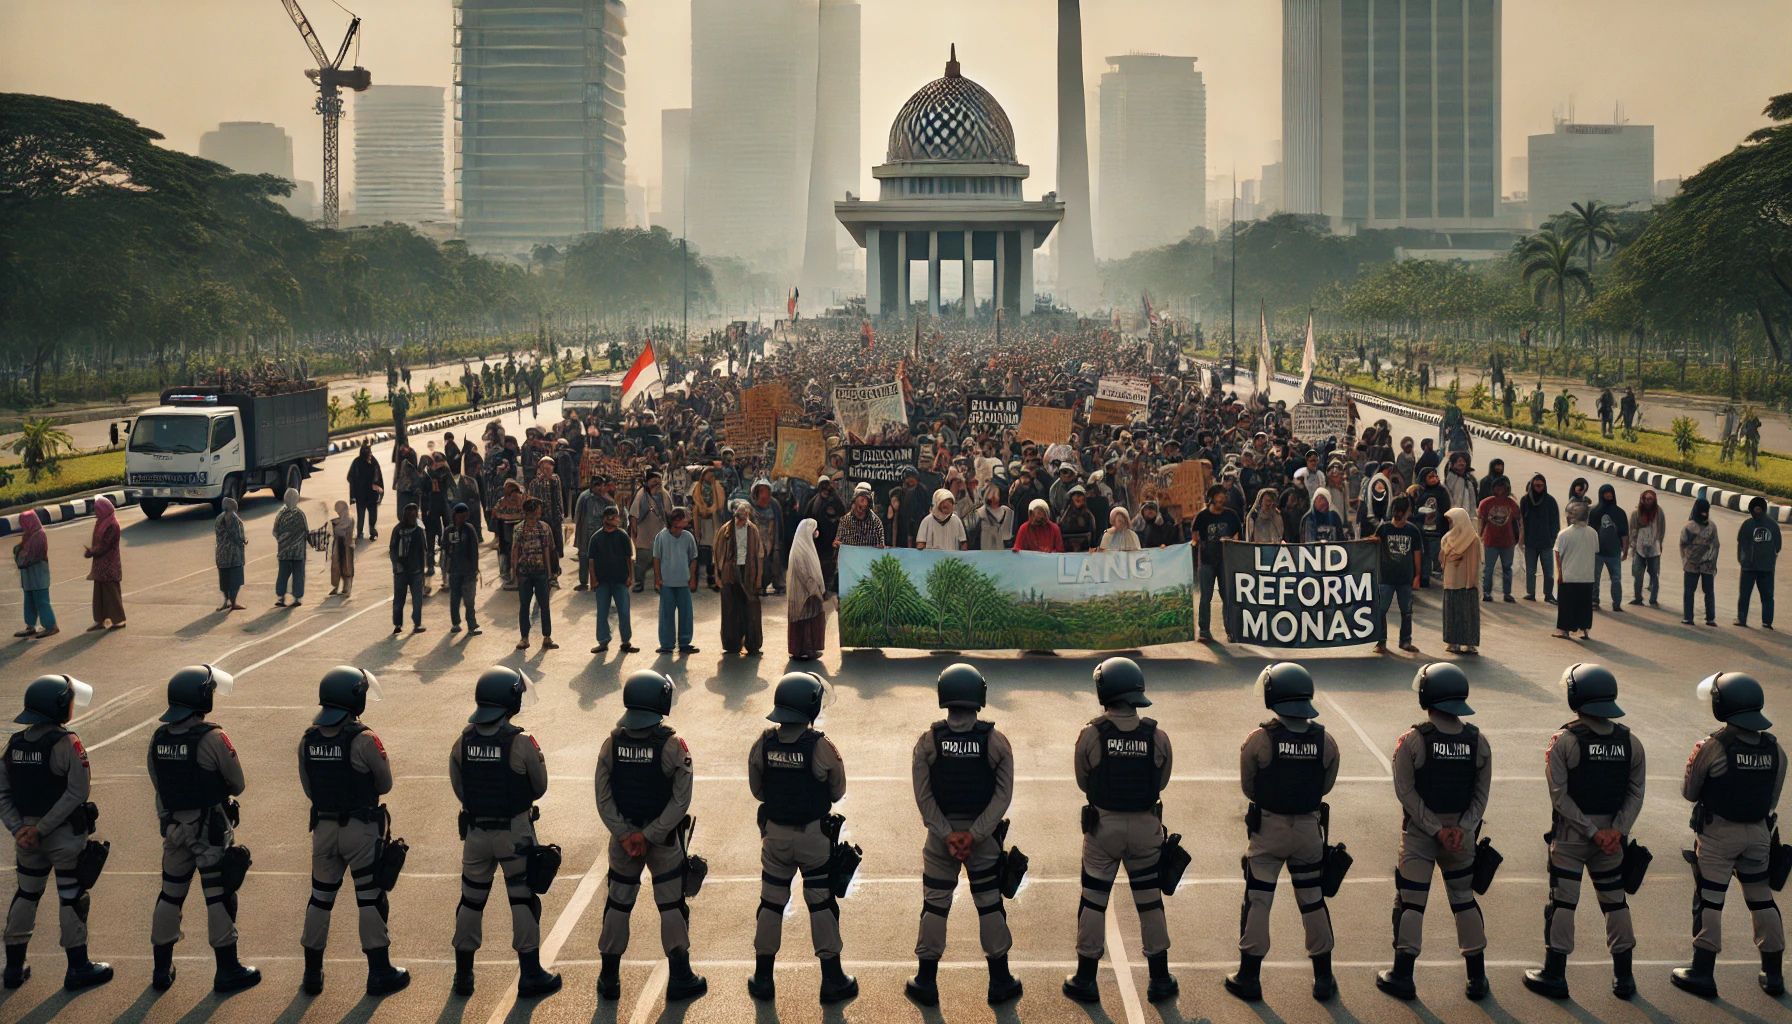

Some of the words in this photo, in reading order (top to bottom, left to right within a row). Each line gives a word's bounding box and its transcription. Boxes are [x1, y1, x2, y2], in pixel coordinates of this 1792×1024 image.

[1058, 551, 1153, 584] LANG
[1254, 544, 1348, 573] LAND
[1234, 572, 1373, 607] REFORM
[1242, 606, 1375, 643] MONAS
